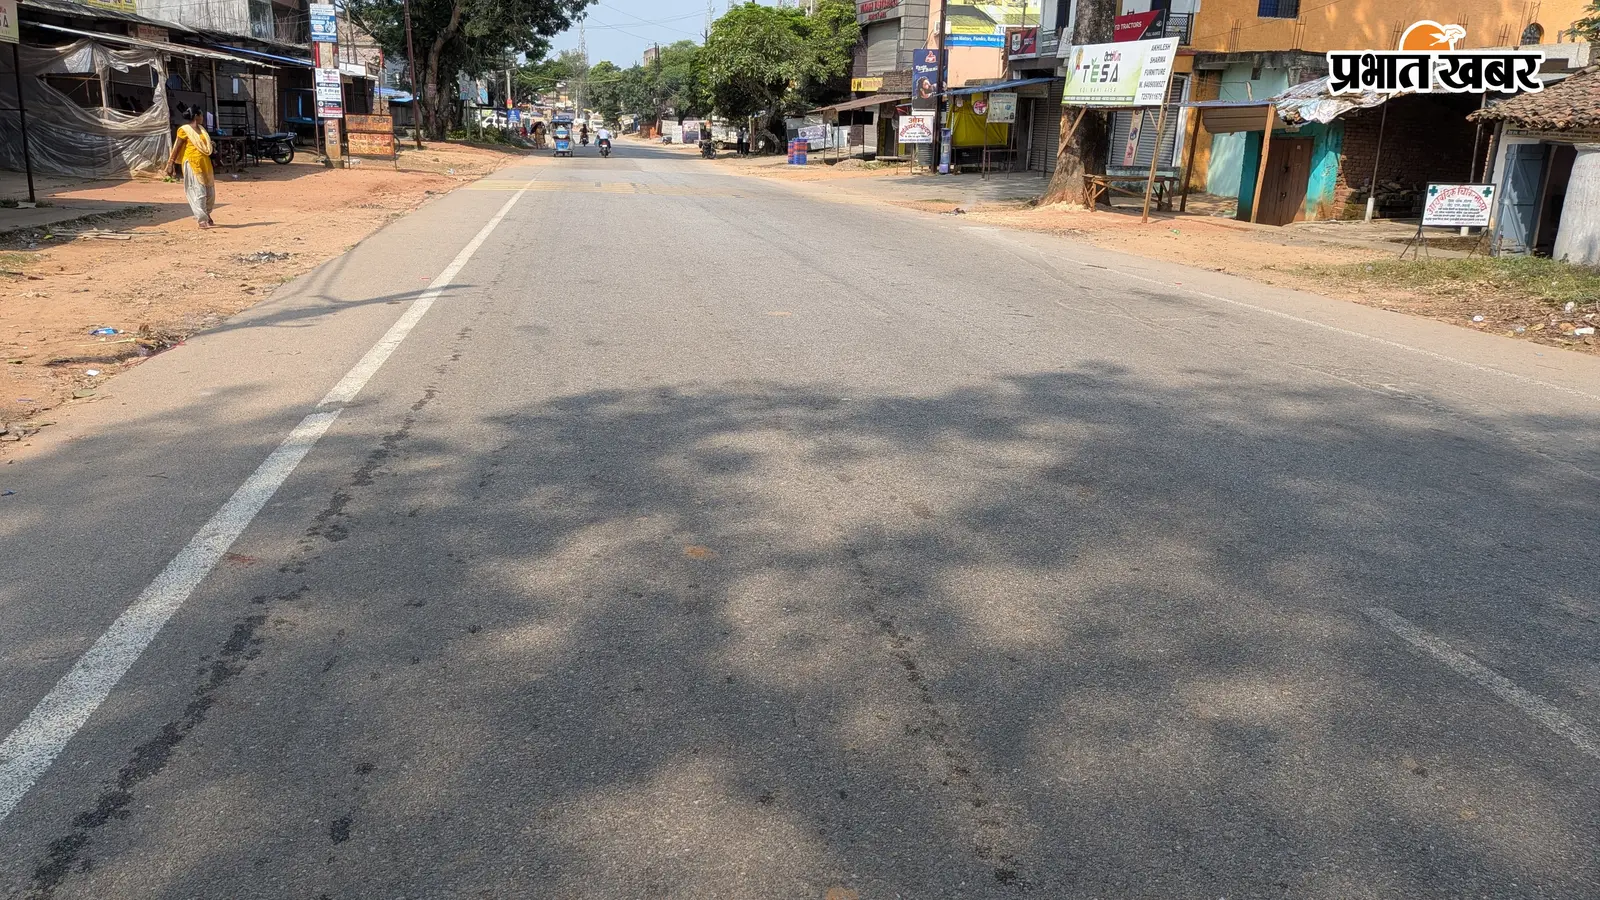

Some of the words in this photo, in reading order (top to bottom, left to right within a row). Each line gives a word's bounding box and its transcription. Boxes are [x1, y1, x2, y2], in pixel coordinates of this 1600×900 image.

[1120, 21, 1143, 30] TRACTORS
[1151, 43, 1171, 52] AKHILESH
[1149, 56, 1166, 64] SHARMA
[1082, 62, 1118, 82] TESA
[1143, 68, 1166, 76] FURNITURE
